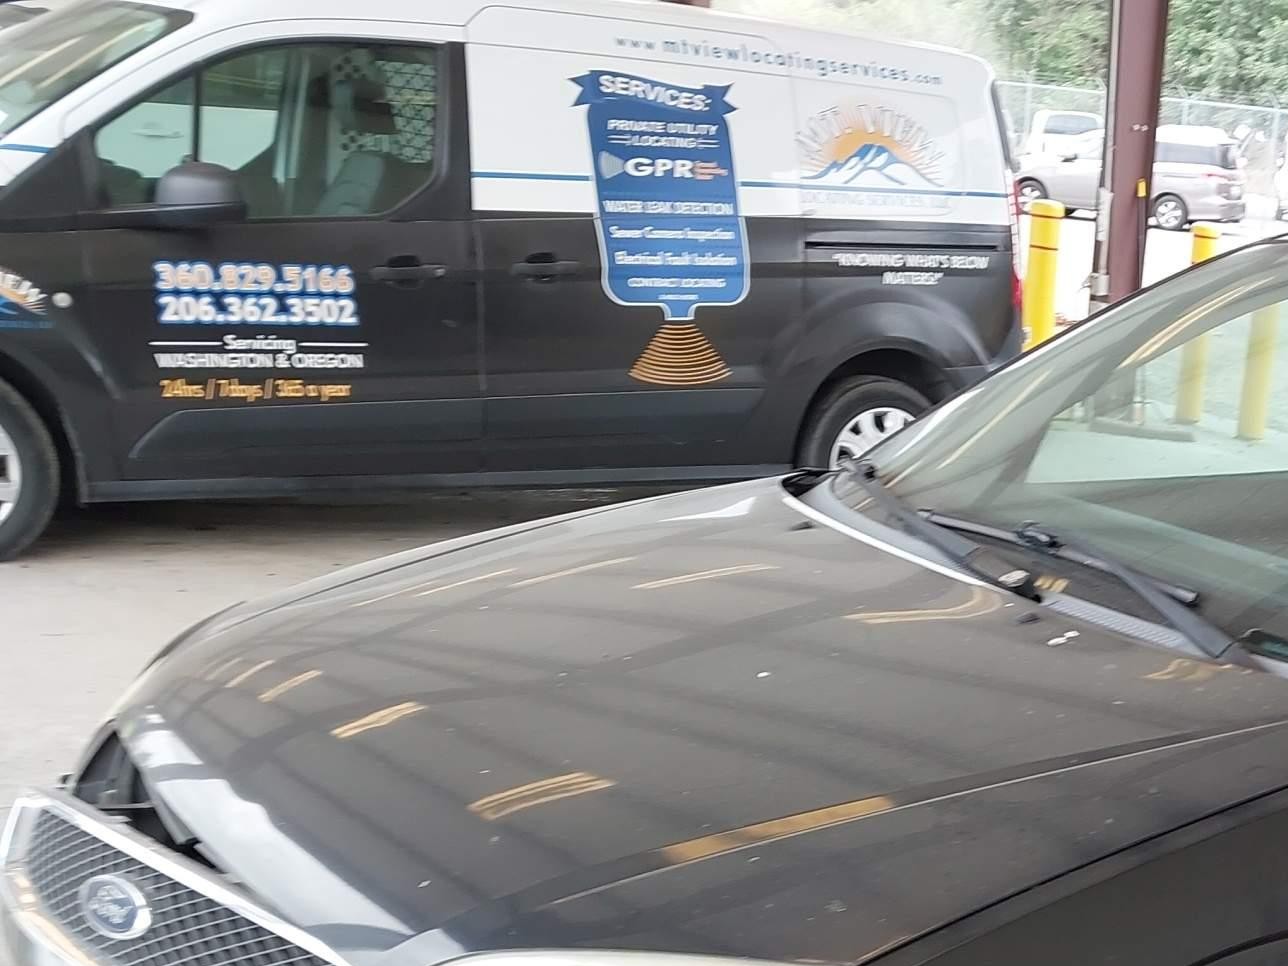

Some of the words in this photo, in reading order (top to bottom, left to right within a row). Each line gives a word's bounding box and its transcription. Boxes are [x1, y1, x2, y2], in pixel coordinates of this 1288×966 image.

[599, 74, 712, 112] SERVICES:
[607, 119, 667, 133] PRIVATE
[667, 122, 719, 136] UTILITY
[631, 136, 697, 149] LOCATING
[624, 157, 695, 179] GPR
[673, 202, 734, 215] DETECTION
[154, 261, 355, 294] 360.829.5166
[159, 295, 360, 325] 206.362.3502
[223, 334, 297, 354] Servicing
[154, 353, 274, 368] WASHINGTON
[275, 354, 291, 368] &
[291, 353, 365, 368] OREGON
[159, 378, 205, 397] 24hrs
[205, 378, 216, 400] /
[216, 378, 263, 401] 7days
[264, 378, 274, 400] /
[275, 379, 304, 397] 365
[305, 384, 317, 397] a
[318, 384, 352, 401] year
